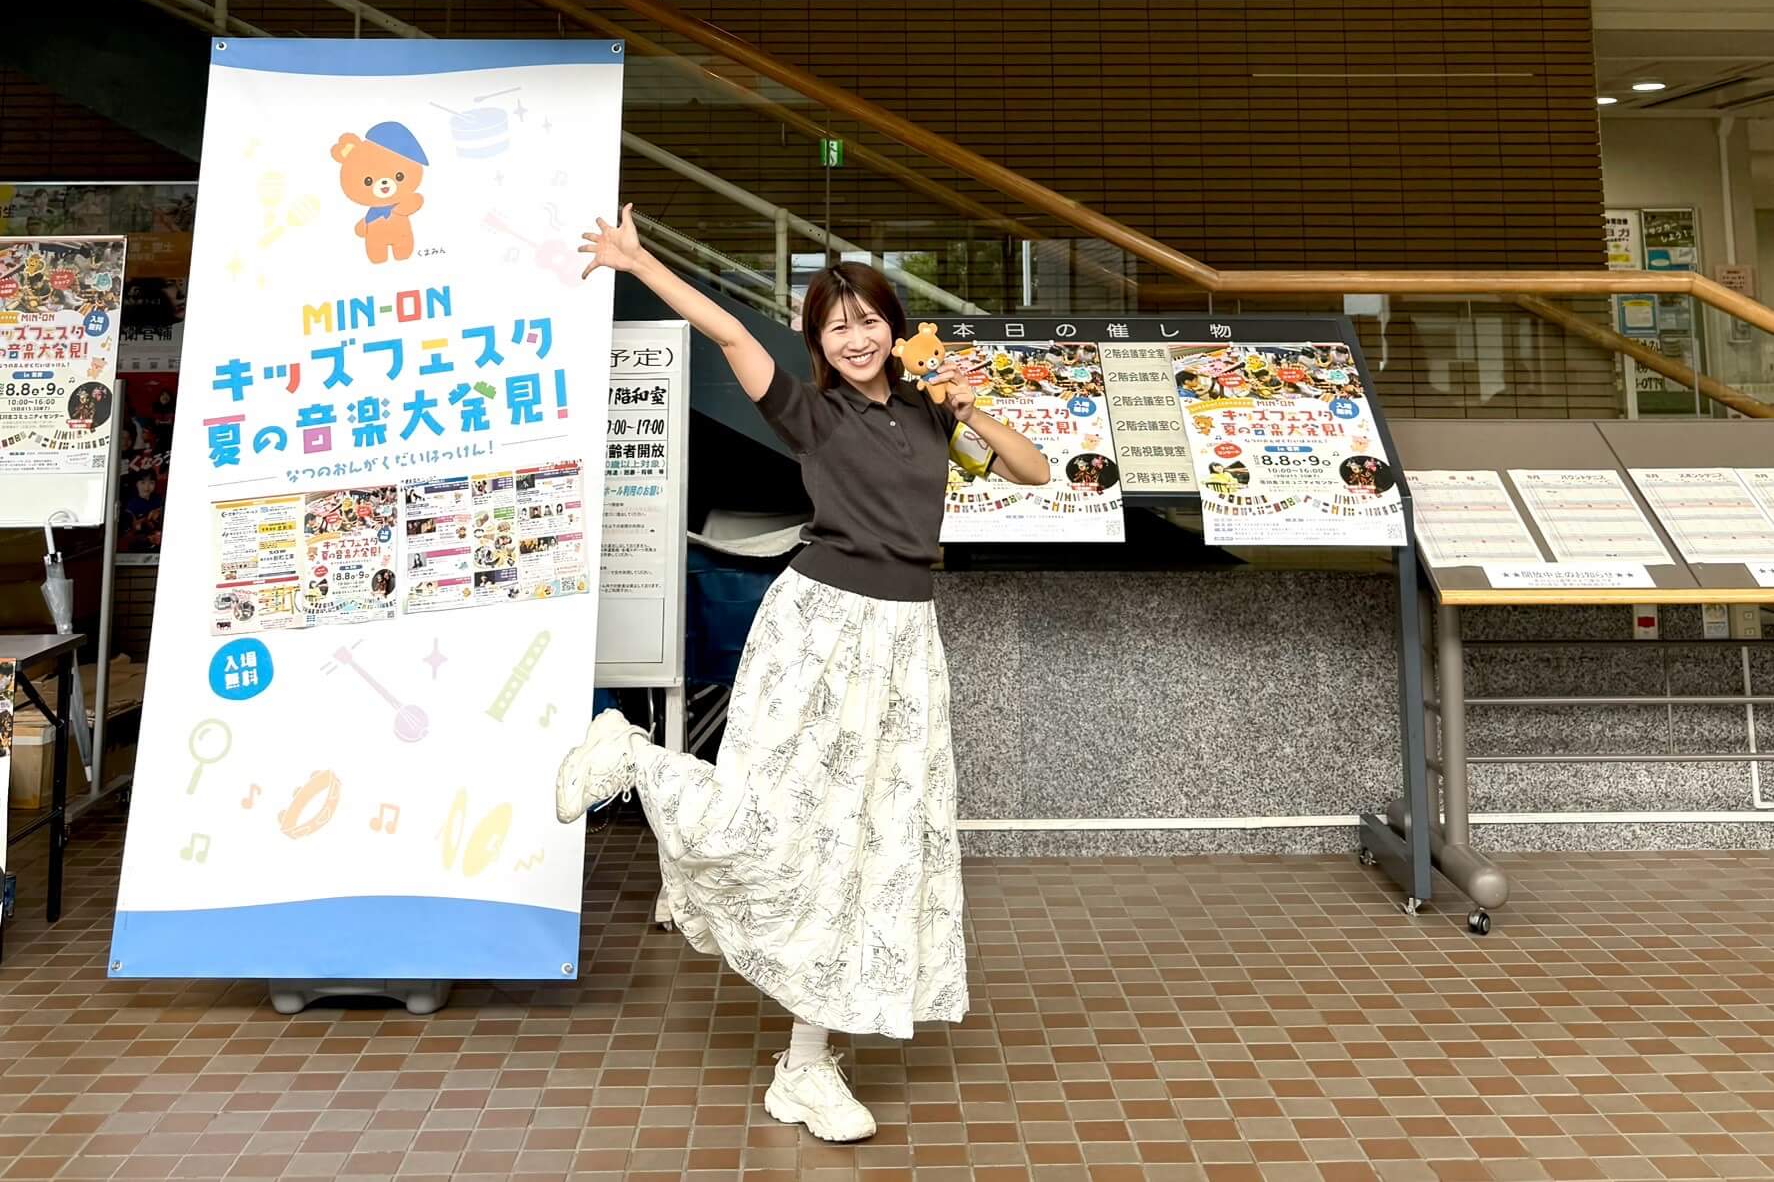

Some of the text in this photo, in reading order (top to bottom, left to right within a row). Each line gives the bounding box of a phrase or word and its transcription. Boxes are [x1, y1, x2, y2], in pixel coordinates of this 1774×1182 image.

[417, 246, 446, 257] くまみん
[303, 285, 452, 335] MIN-ON
[952, 322, 1233, 338] 本日の催し物
[212, 317, 554, 402] キッズフェスタ
[610, 347, 674, 367] 予定)
[1108, 372, 1170, 383] 2階会議室A
[1112, 396, 1176, 406] 2階会議室B
[203, 368, 568, 468] 夏の音楽大発見!
[1115, 421, 1181, 431] 2階会議室C
[606, 444, 665, 459] 齢者開放
[286, 440, 494, 483] なつのおんがくだいはっけん!
[1125, 472, 1190, 484] 2階料理室
